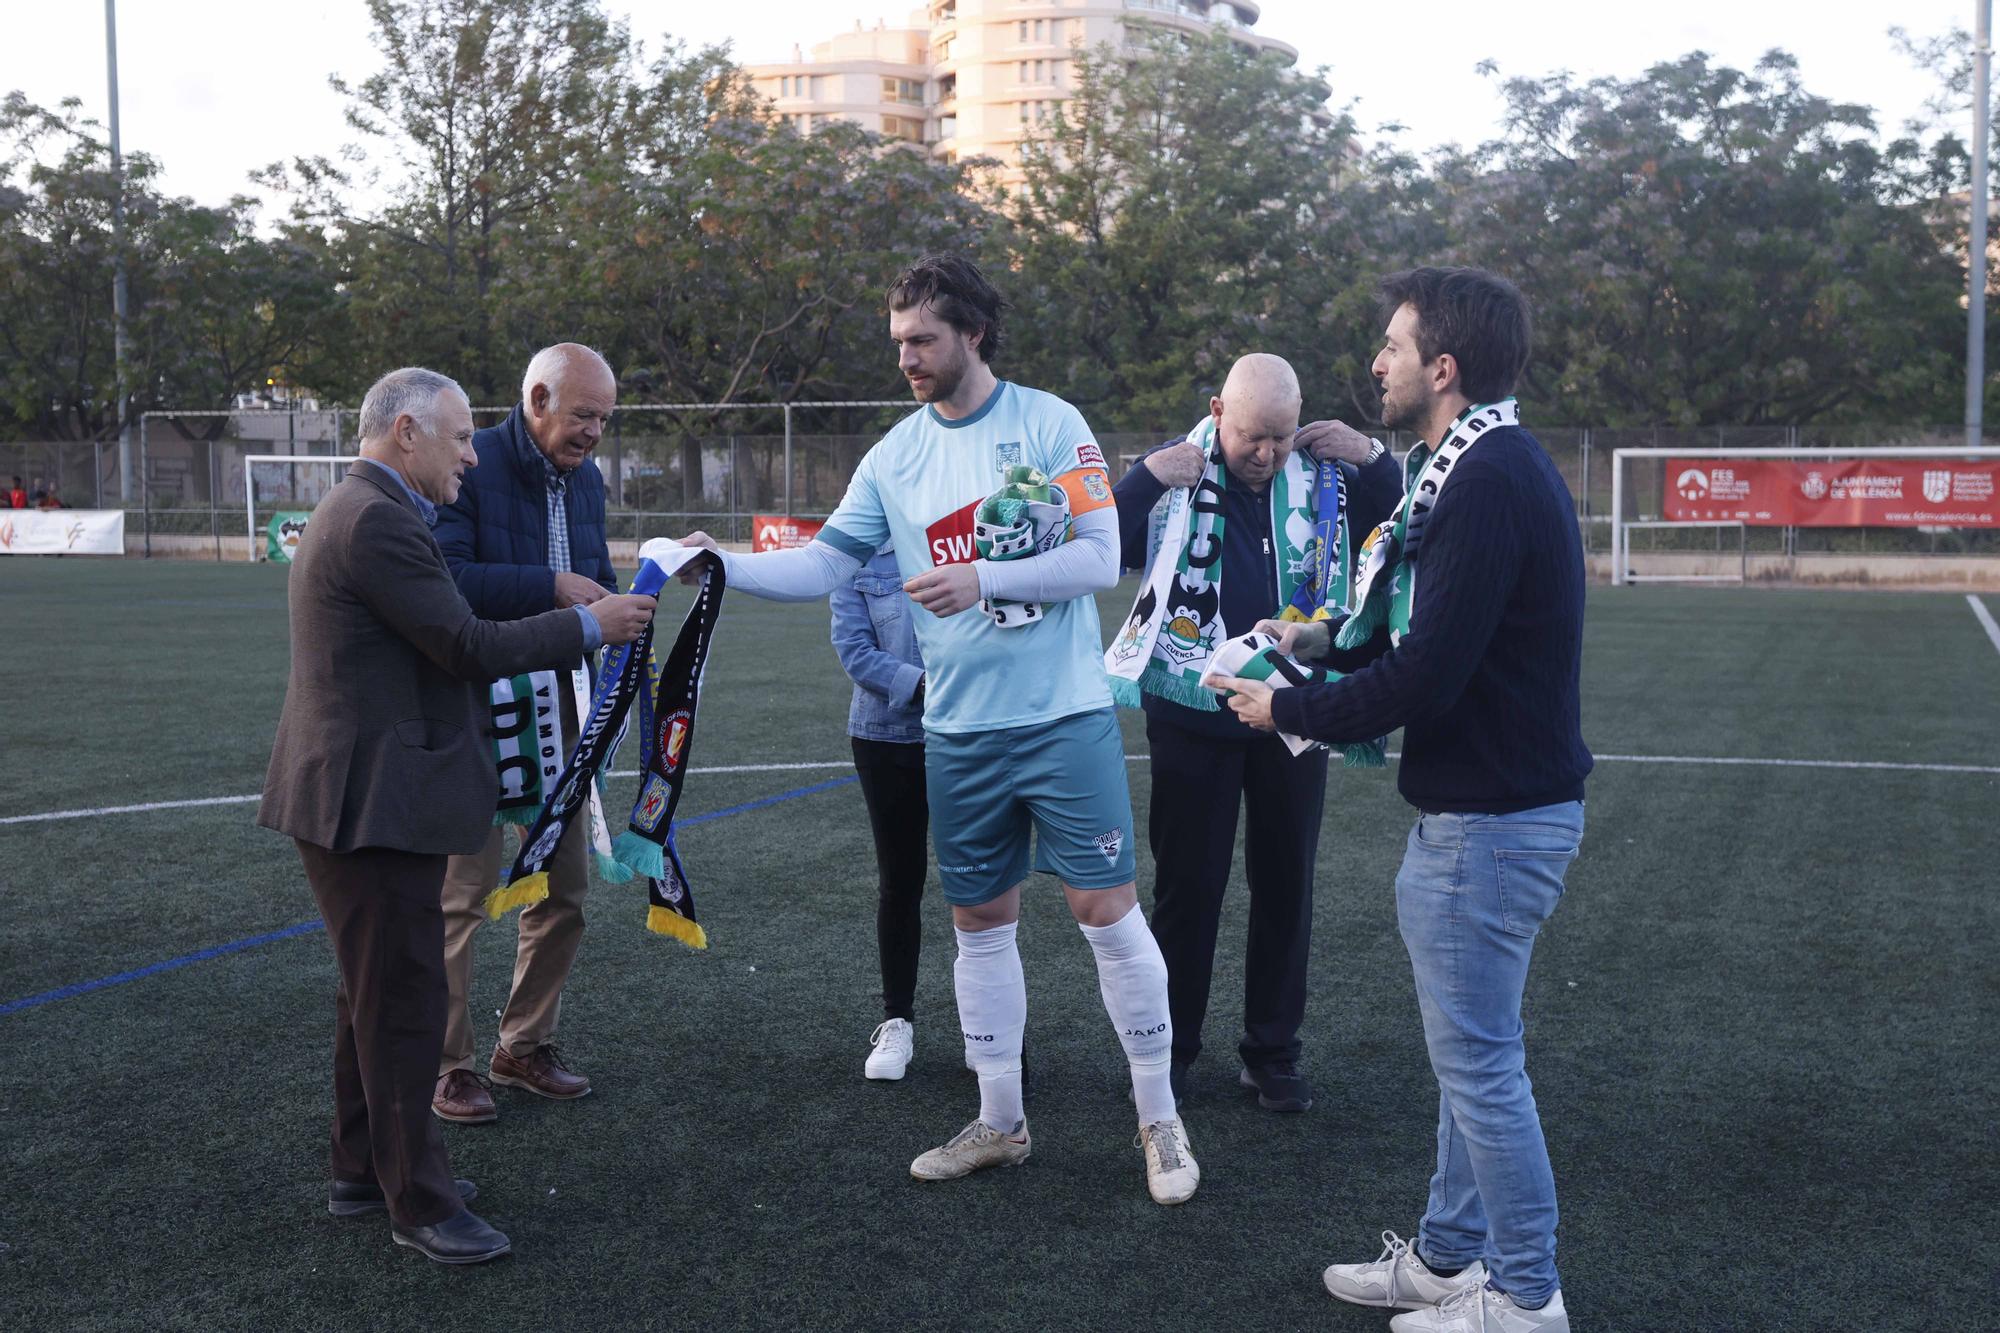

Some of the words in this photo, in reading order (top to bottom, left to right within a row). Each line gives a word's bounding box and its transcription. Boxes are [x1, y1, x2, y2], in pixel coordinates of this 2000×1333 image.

[1165, 643, 1196, 659] CUENCA
[535, 685, 558, 777] VAMOS
[963, 1033, 995, 1042] AKO
[1125, 1023, 1167, 1037] JAKO
